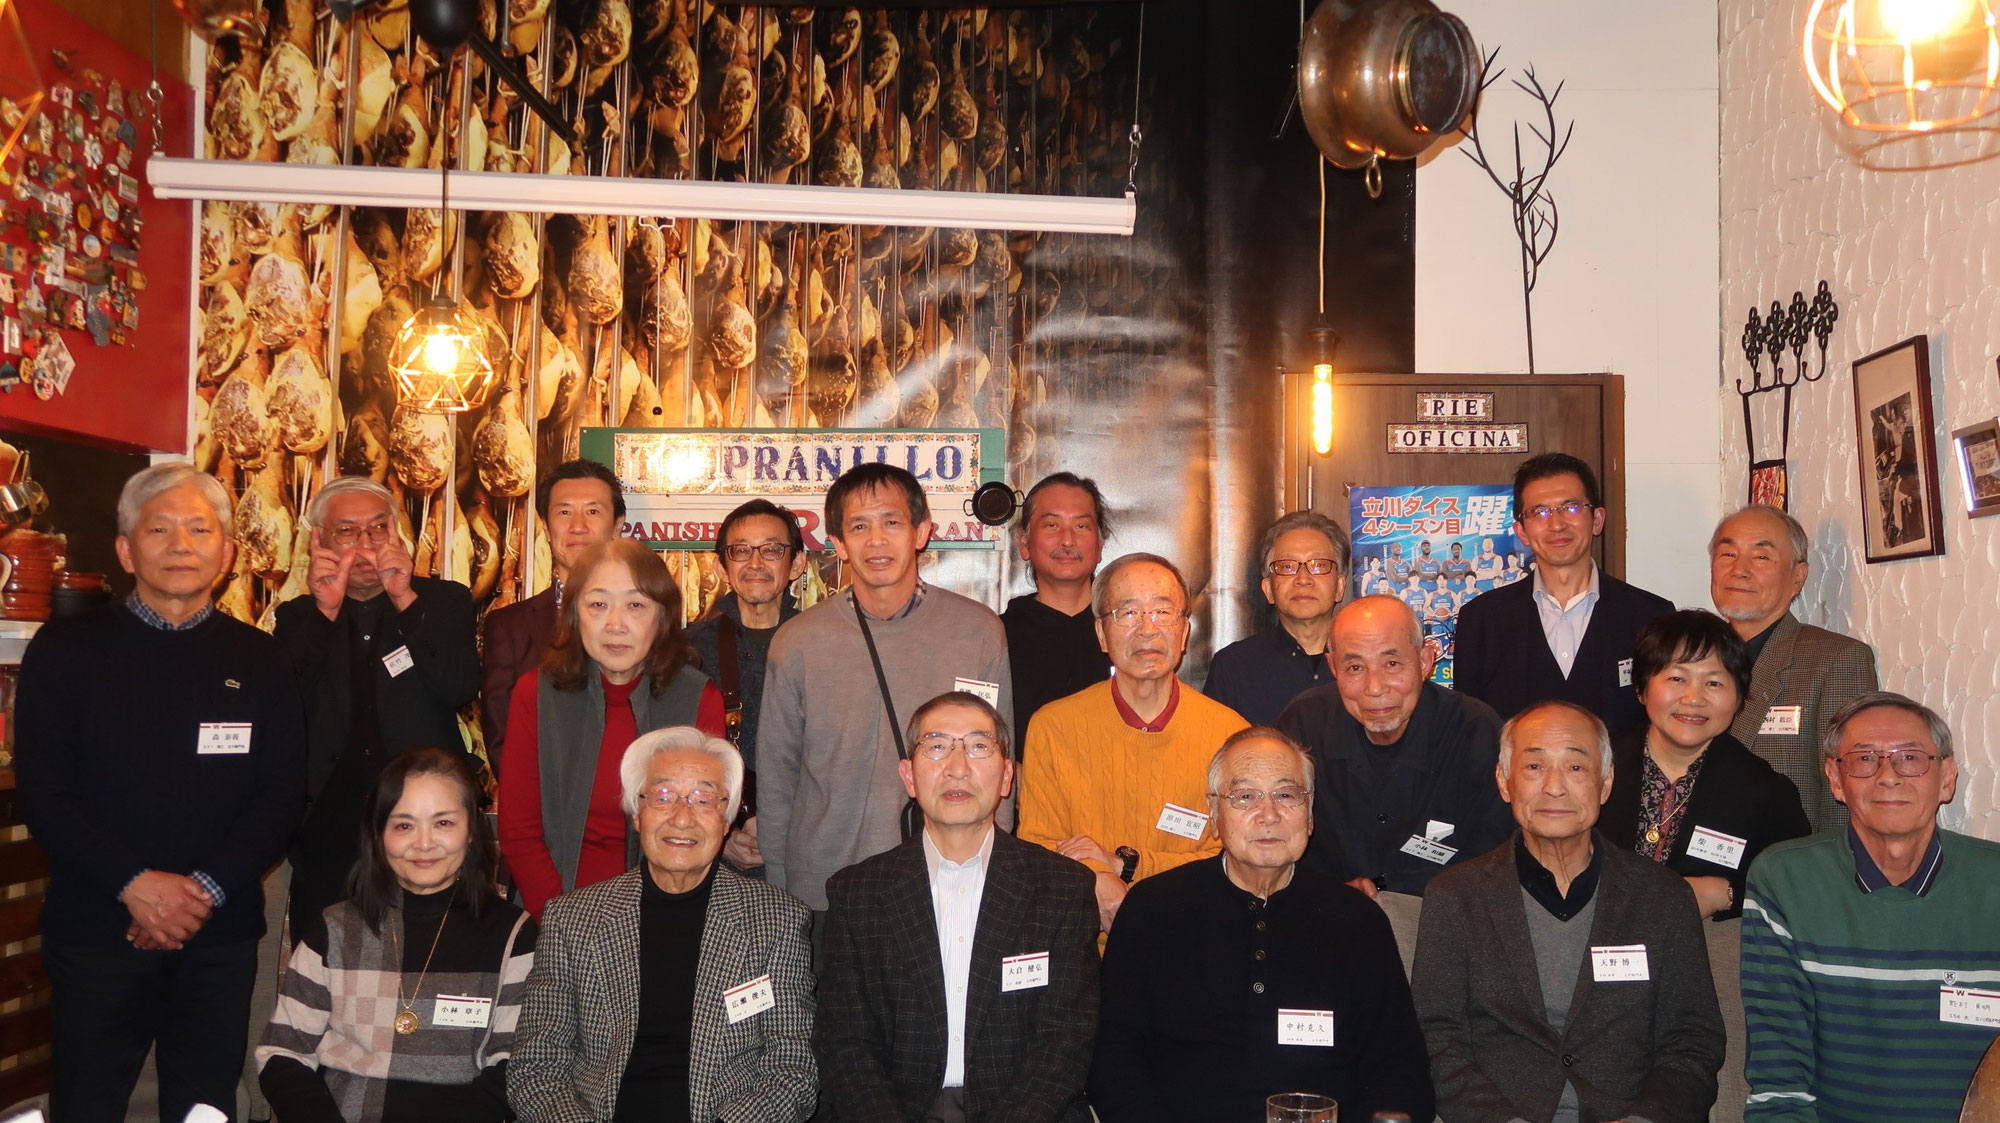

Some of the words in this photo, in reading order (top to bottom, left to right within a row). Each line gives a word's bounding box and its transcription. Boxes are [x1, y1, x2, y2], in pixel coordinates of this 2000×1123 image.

[1432, 399, 1478, 416] RIE
[1402, 430, 1512, 447] OFICINA
[1362, 496, 1461, 518] 立川ダイス
[1462, 495, 1514, 536] 躍
[620, 521, 722, 541] PANISH
[1362, 518, 1461, 536] 4シーズン目
